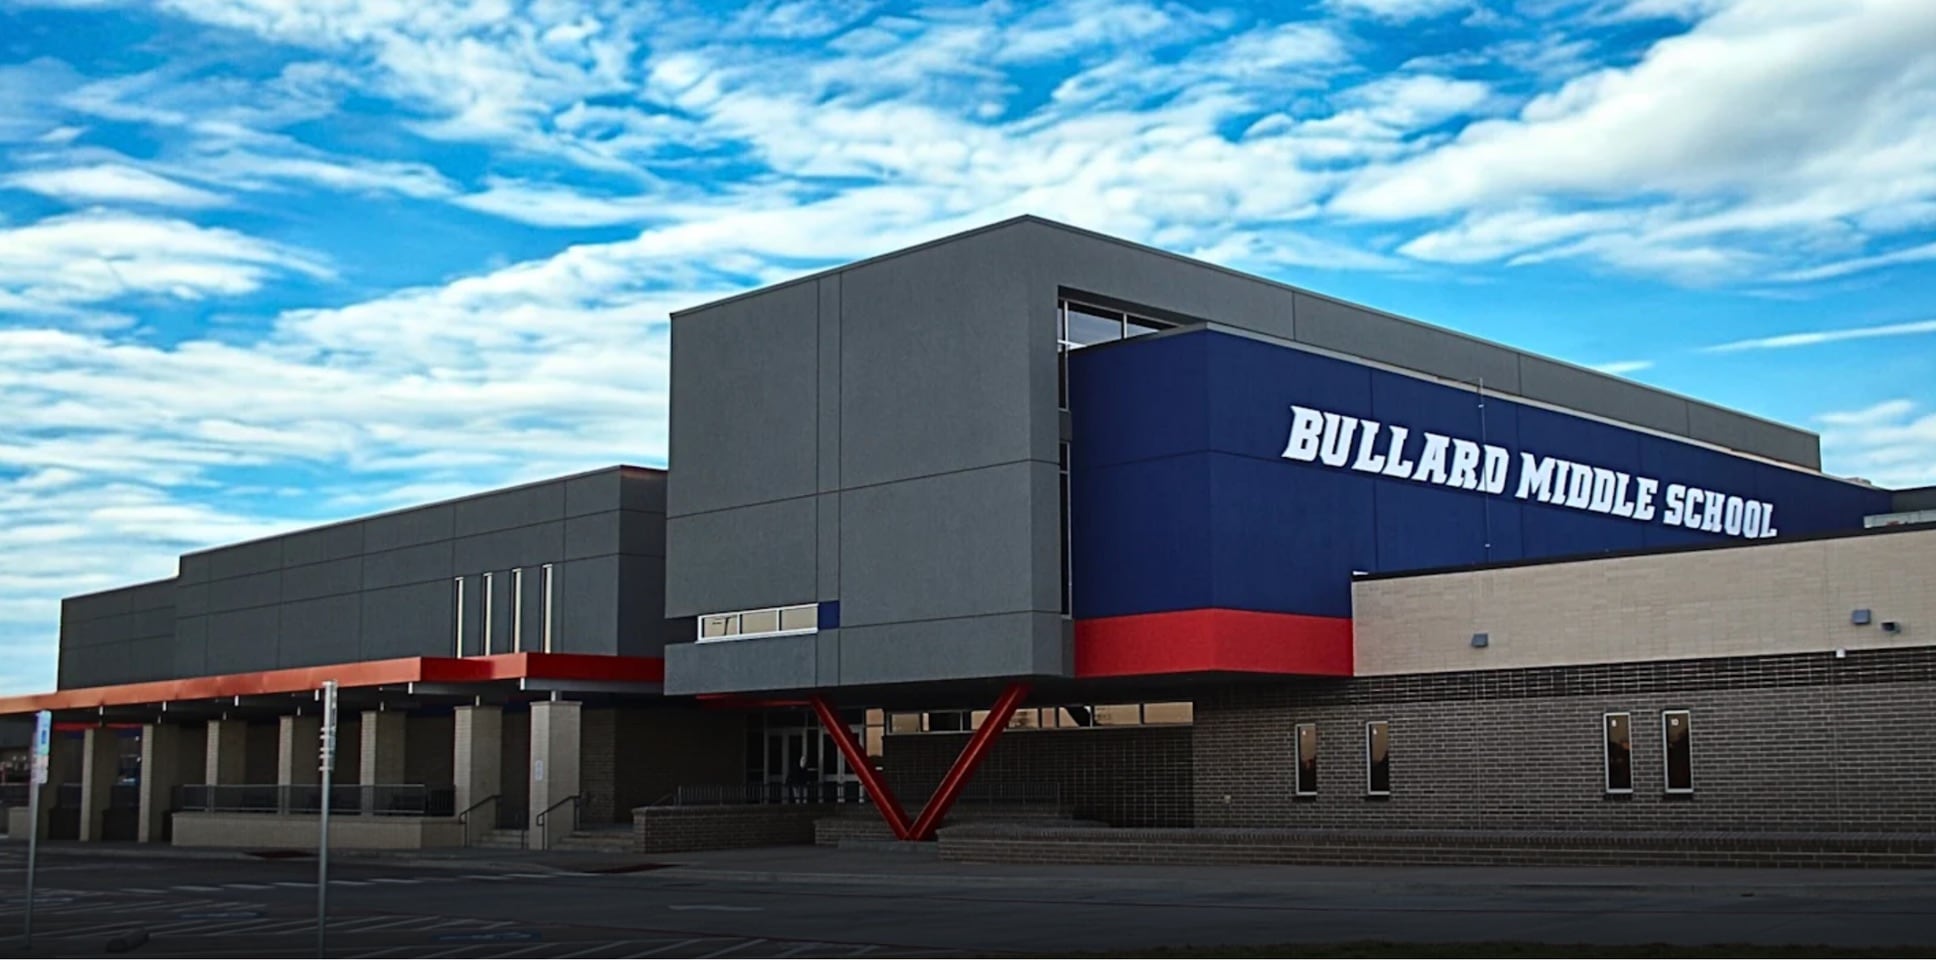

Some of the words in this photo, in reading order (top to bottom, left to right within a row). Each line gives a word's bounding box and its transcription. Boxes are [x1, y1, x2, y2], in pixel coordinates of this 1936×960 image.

[1281, 405, 1510, 495] BULLARD
[1515, 452, 1659, 521] MIDDLE
[1663, 484, 1778, 540] SCHOOL
